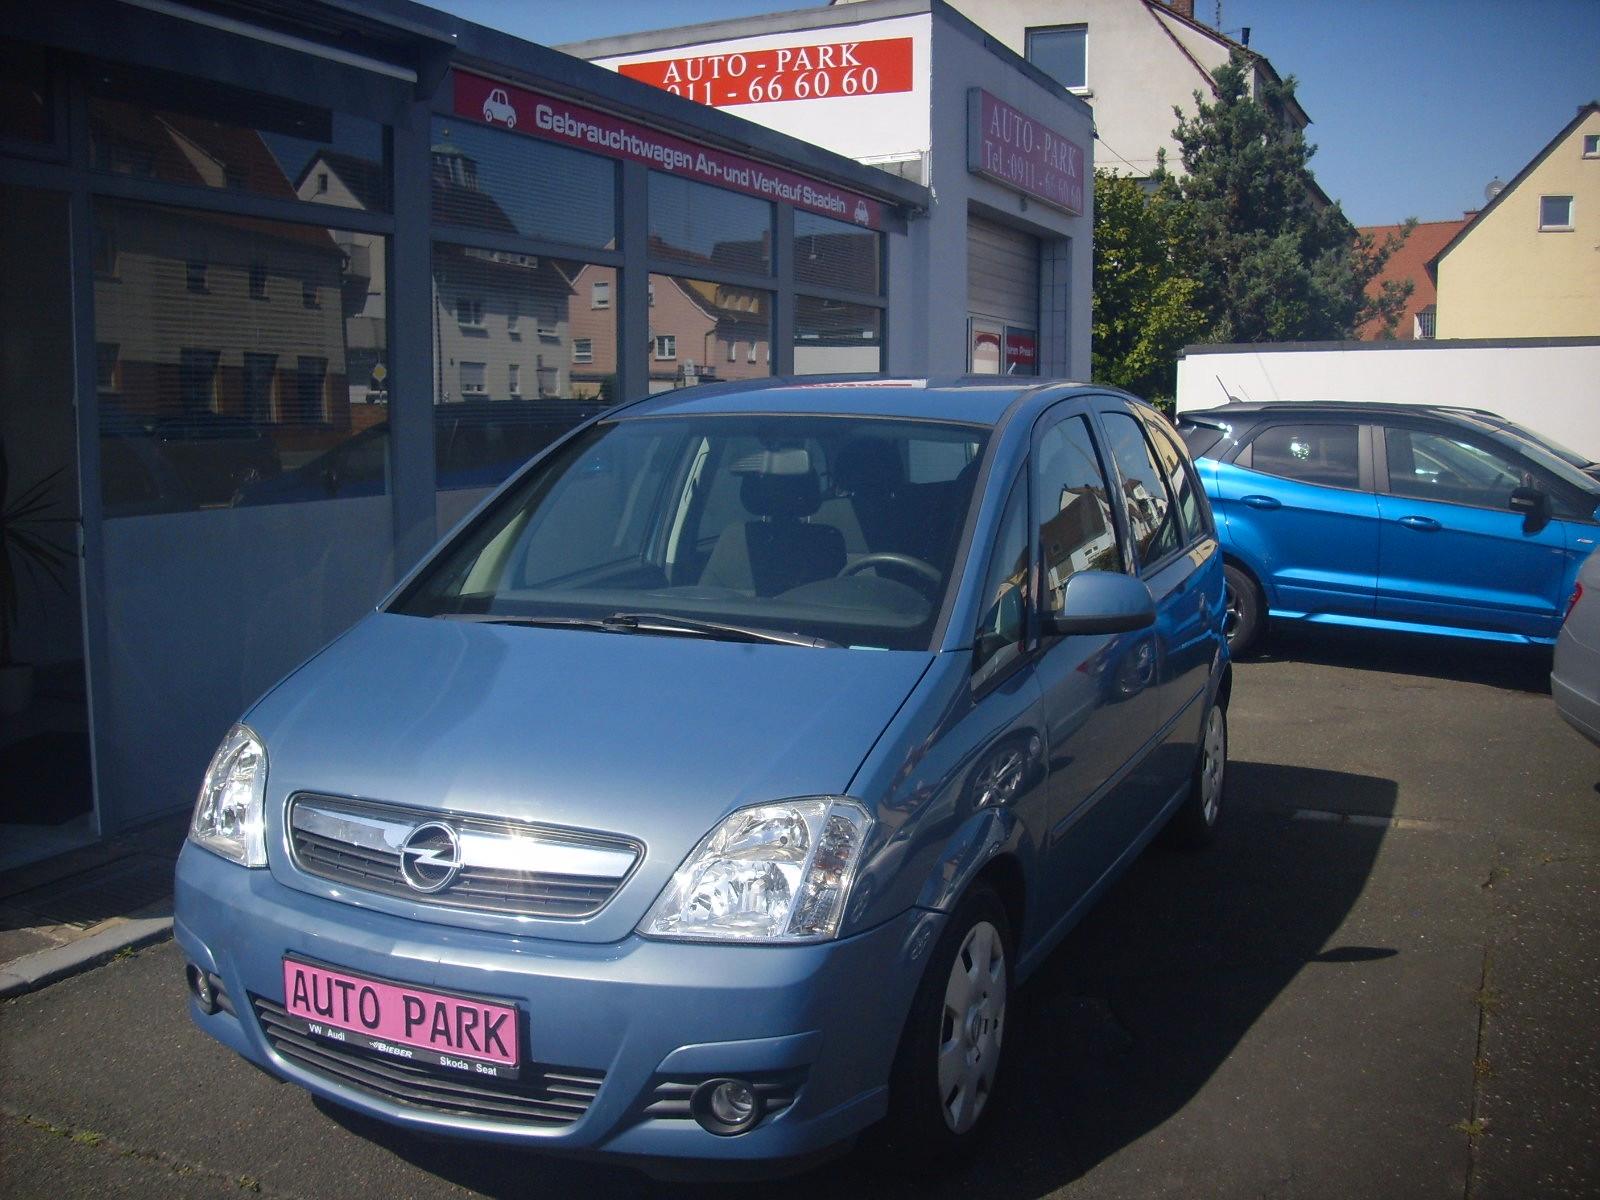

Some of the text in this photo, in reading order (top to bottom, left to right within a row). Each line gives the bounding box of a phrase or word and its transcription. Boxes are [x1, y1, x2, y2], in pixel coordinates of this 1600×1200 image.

[663, 54, 747, 84] AUTO
[776, 43, 862, 73] PARK
[748, 74, 783, 102] 66
[795, 70, 830, 98] 60
[842, 66, 879, 95] 60
[535, 104, 693, 170] Gebrauchtwagen
[751, 170, 803, 200] Verkauf
[803, 186, 846, 213] Stadeln
[990, 104, 1033, 153] AUTO
[1044, 132, 1077, 178] PARK
[293, 969, 509, 1057] AUTO PARK
[309, 1023, 322, 1035] VW
[327, 1028, 345, 1041] Audi
[440, 1056, 469, 1070] Skoda
[476, 1063, 497, 1076] Seat
